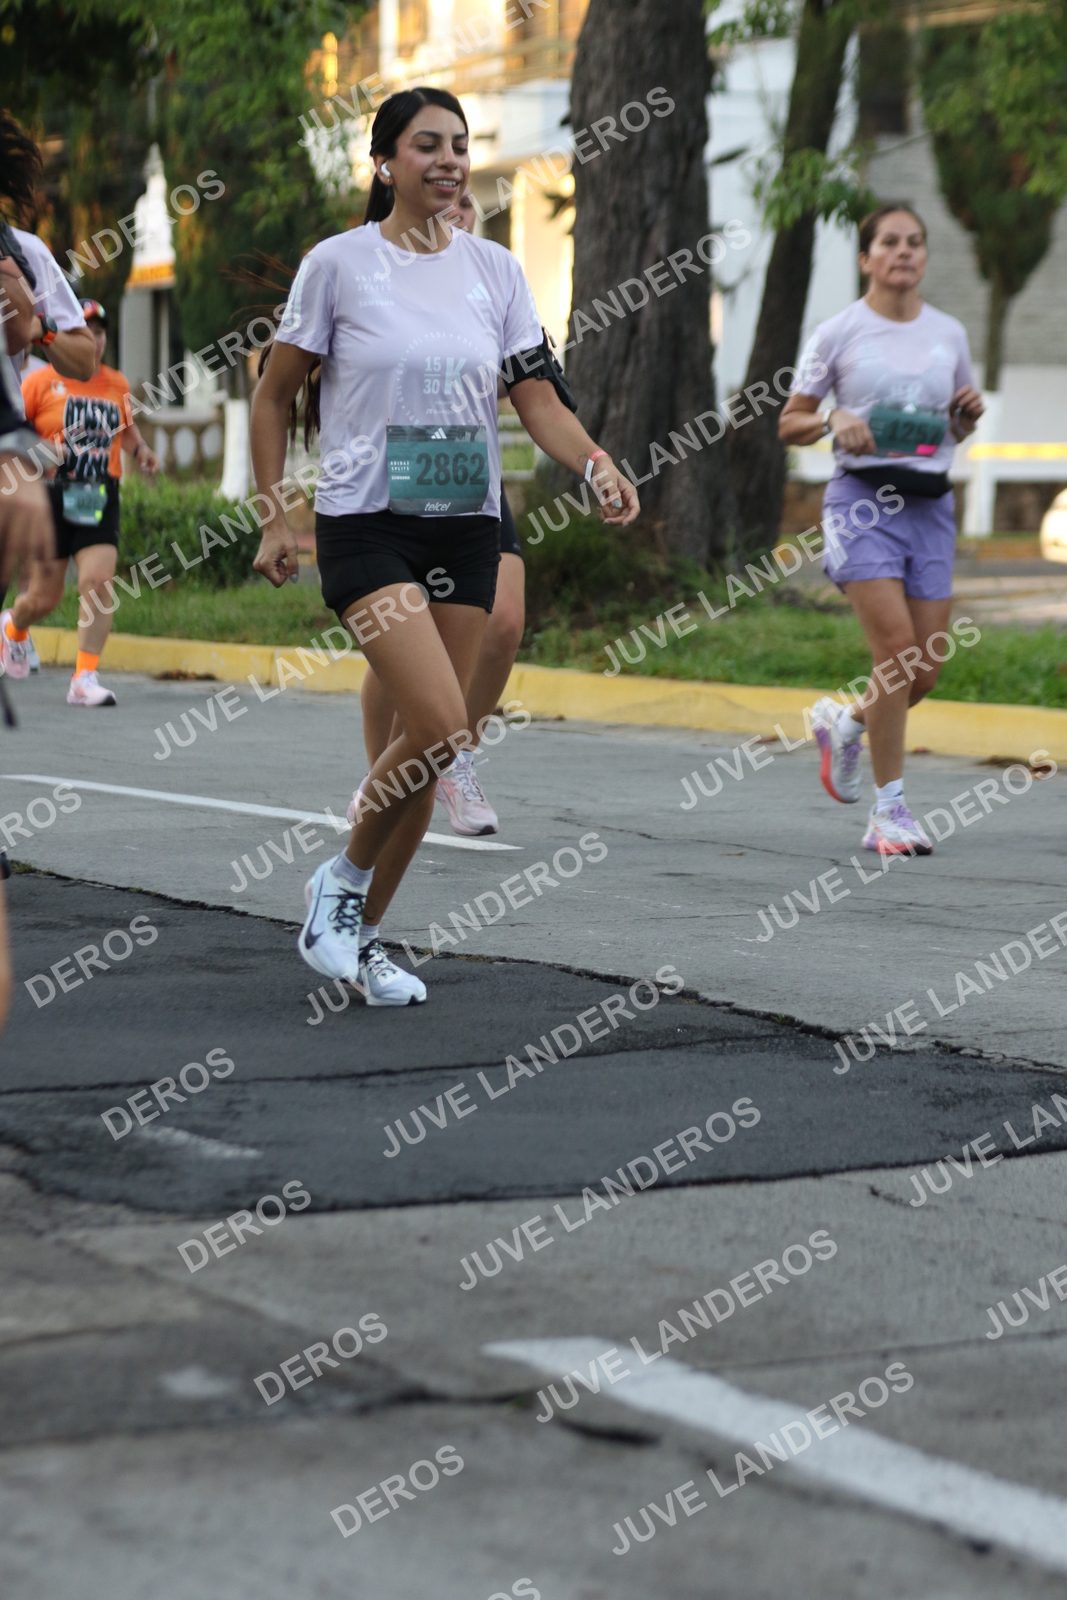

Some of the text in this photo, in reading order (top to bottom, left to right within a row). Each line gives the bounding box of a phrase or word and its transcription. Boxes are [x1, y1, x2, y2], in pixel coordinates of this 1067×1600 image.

[424, 355, 441, 372] 15
[444, 356, 467, 395] K
[423, 378, 440, 394] 30
[416, 452, 485, 486] 2862
[424, 502, 452, 512] telcel
